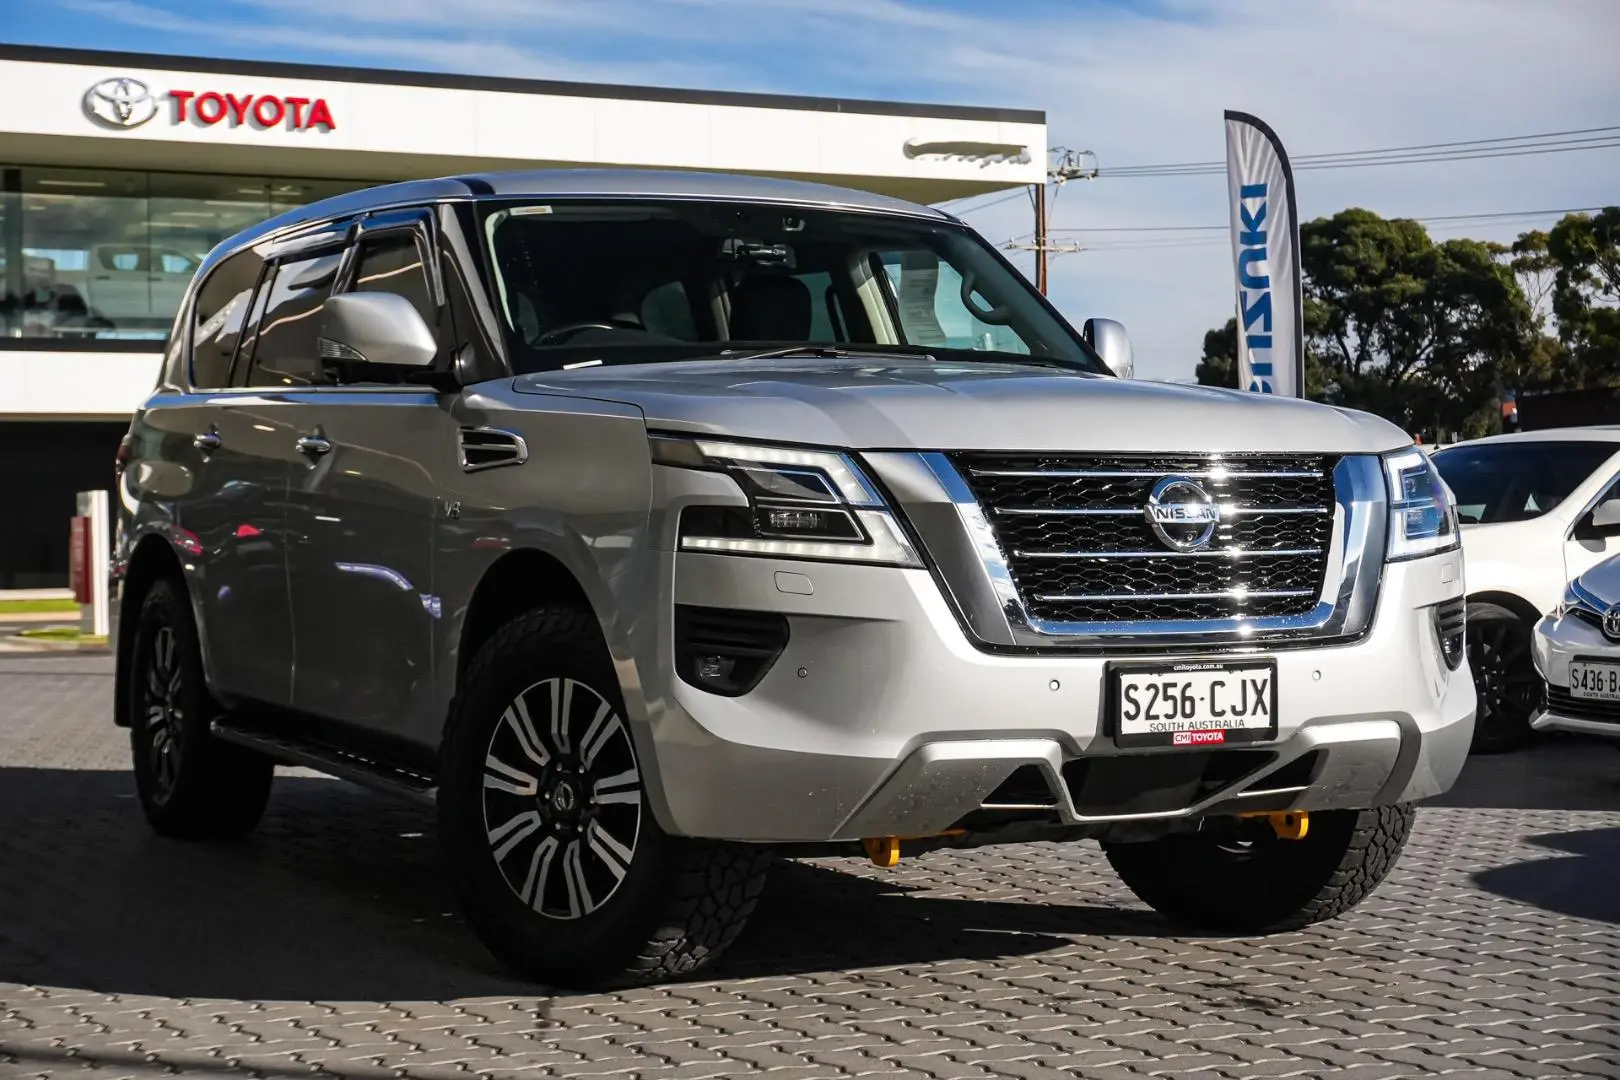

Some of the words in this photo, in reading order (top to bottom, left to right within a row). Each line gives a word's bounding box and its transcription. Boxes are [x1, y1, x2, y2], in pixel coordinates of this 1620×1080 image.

[169, 90, 336, 130] TOYOTA
[1173, 663, 1224, 672] cmitoyota.com.au
[1149, 721, 1185, 733] SOUTH
[1189, 719, 1245, 732] AUSTRALIA
[1192, 731, 1224, 742] TOYOTA
